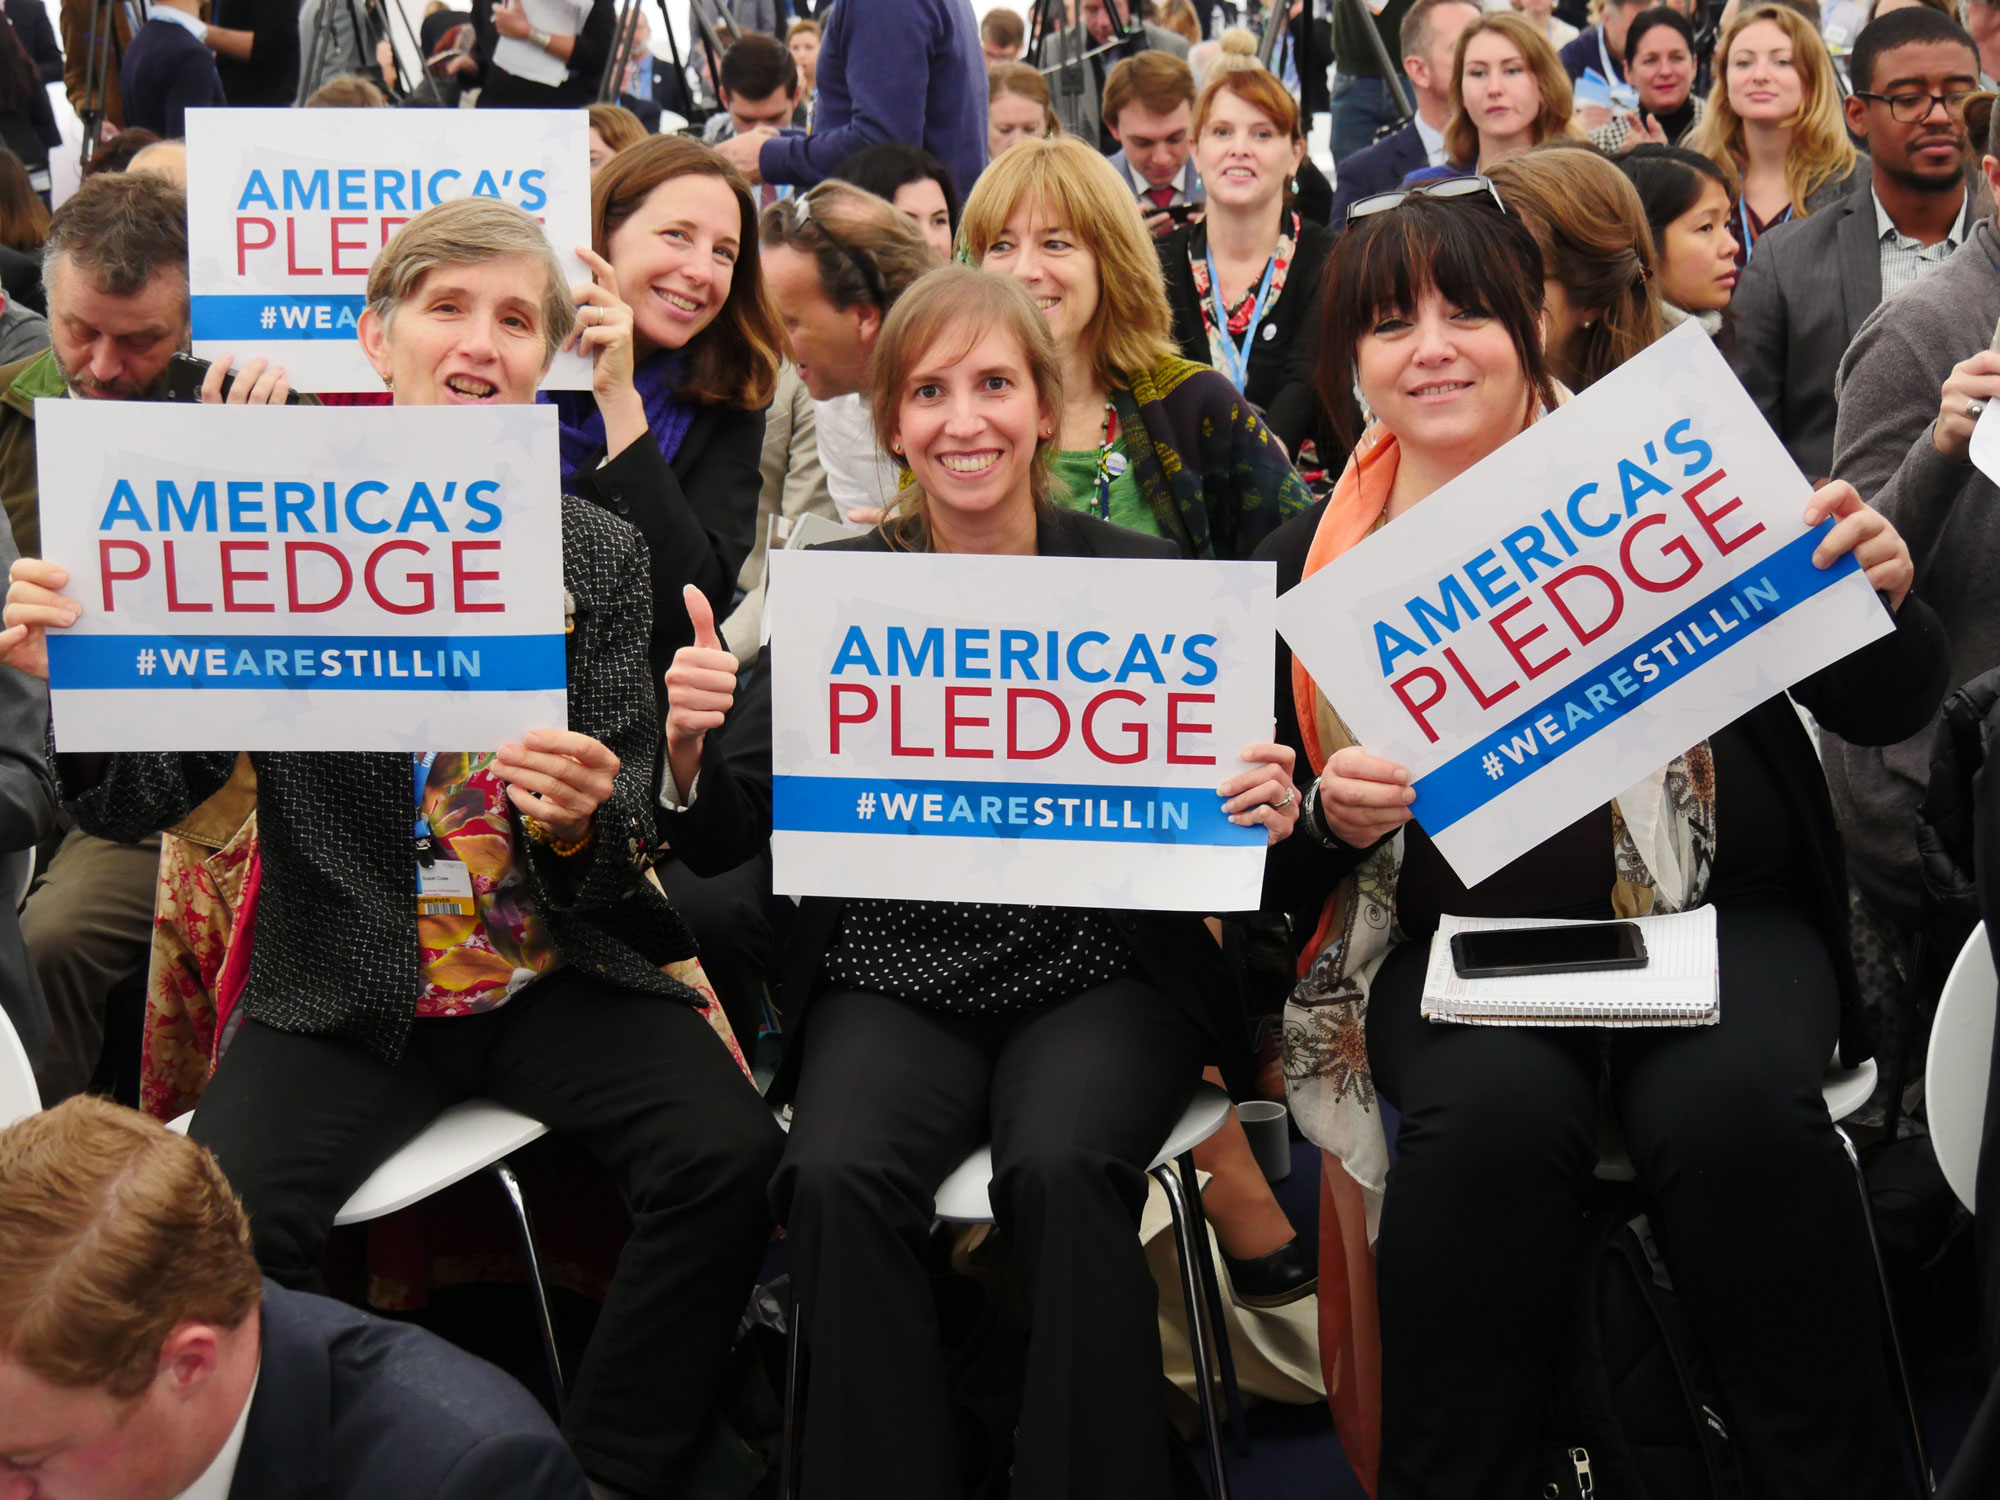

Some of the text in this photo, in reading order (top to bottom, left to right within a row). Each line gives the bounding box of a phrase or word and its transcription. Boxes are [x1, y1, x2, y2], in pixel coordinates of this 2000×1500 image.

[238, 169, 547, 211] AMERICA'S
[99, 480, 503, 535] AMERICA'S
[99, 540, 505, 615] PLEDGE
[1374, 417, 1713, 677] AMERICA'S
[1391, 469, 1766, 743] PLEDGE
[135, 648, 481, 678] #WEARESTILLIN
[830, 625, 1218, 687] AMERICA'S
[1482, 577, 1780, 781] #WEARESTILLIN
[829, 682, 1216, 765] PLEDGE
[856, 791, 1189, 830] #WEARESTILLIN
